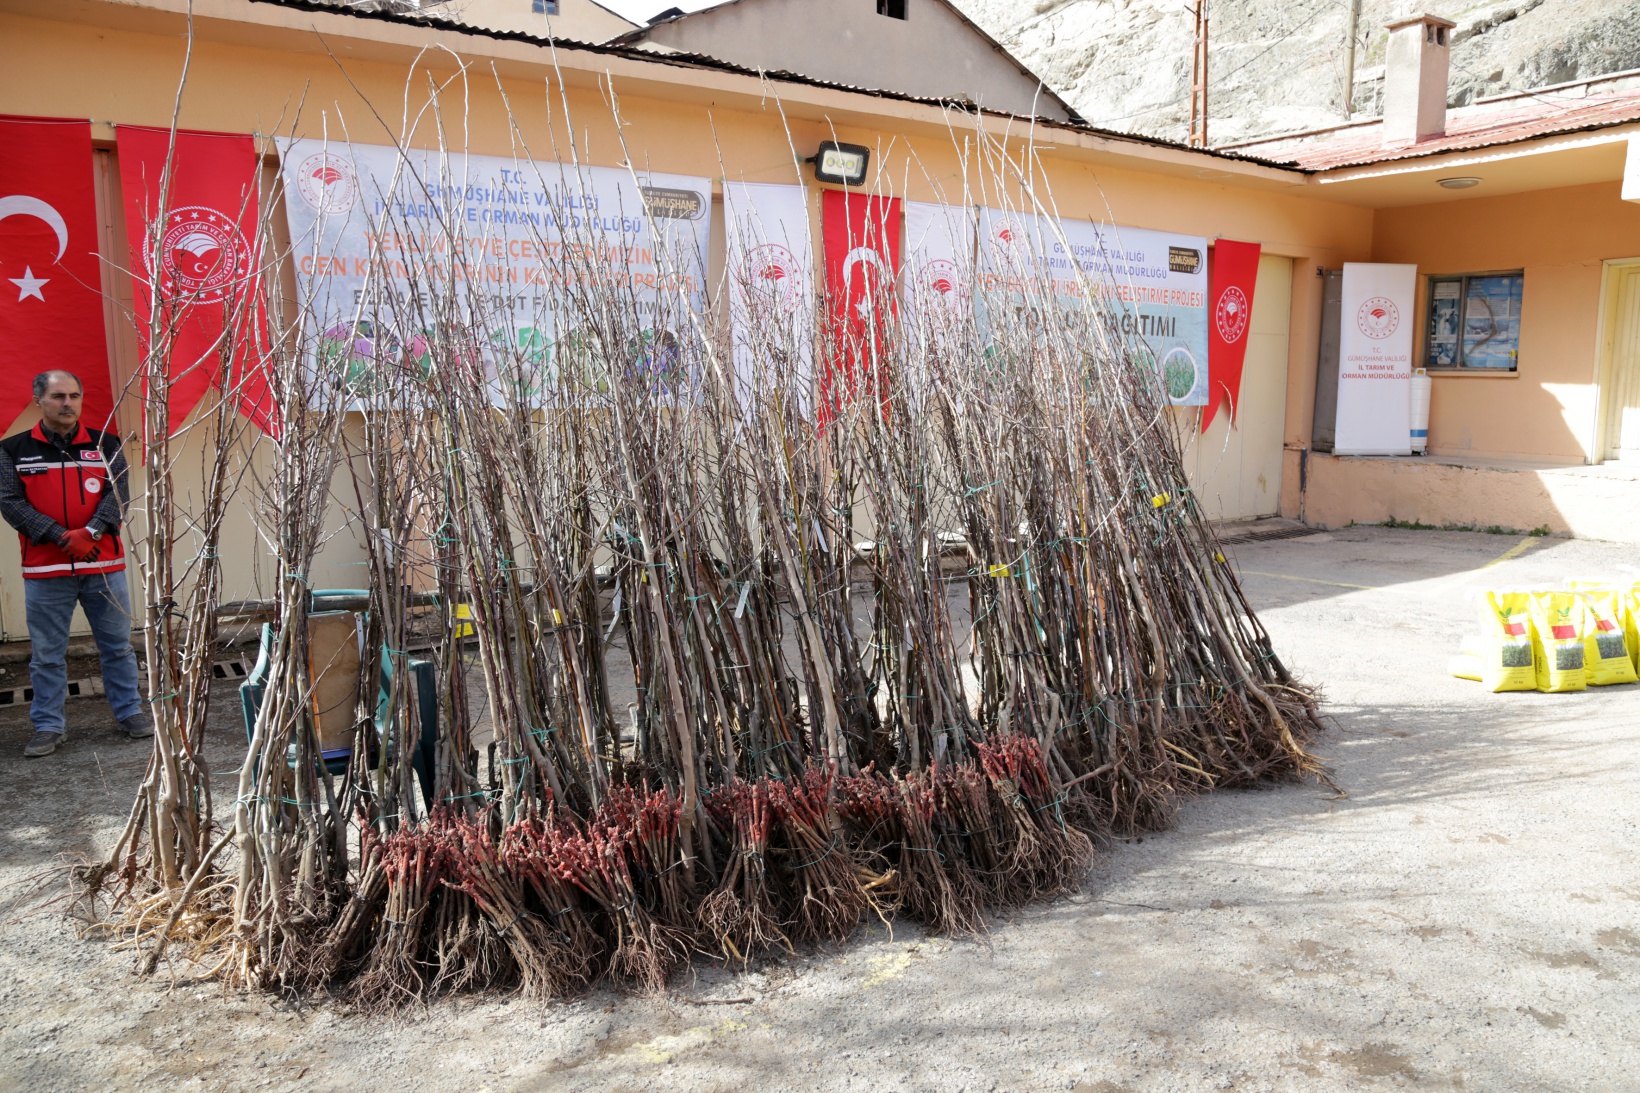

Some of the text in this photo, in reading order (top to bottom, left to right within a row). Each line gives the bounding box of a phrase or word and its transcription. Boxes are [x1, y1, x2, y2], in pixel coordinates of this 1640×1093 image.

[502, 169, 527, 185] T.C.
[481, 208, 540, 227] ORMAN
[546, 211, 641, 233] MÜDRLÜĞÜ
[301, 255, 347, 277] GEN
[1170, 289, 1205, 307] PROJESİ
[1347, 354, 1407, 362] GÜMÜŞHANE VALİLİĞİ
[1368, 372, 1410, 380] MÜDÜRLÜĞÜ
